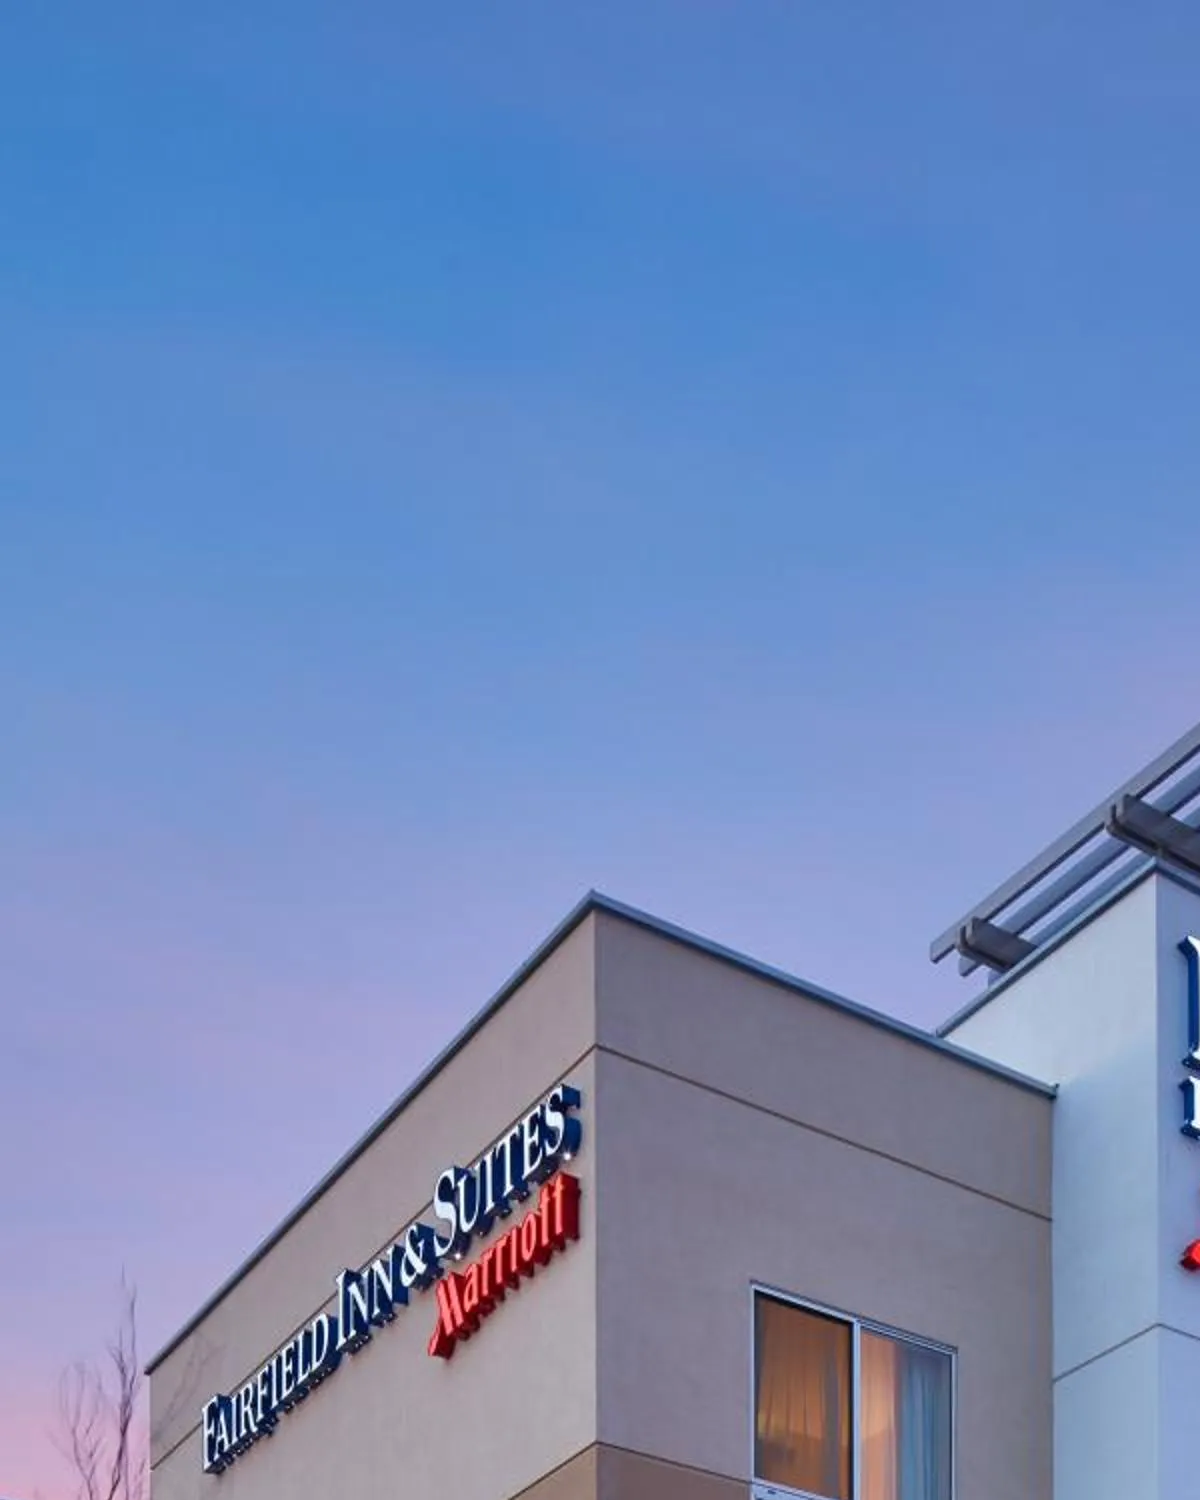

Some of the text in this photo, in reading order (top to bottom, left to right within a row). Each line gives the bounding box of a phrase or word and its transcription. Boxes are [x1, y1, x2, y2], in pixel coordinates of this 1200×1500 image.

[201, 1083, 582, 1474] FAIRFIELD INN & SUITES
[427, 1170, 582, 1360] Marriott
